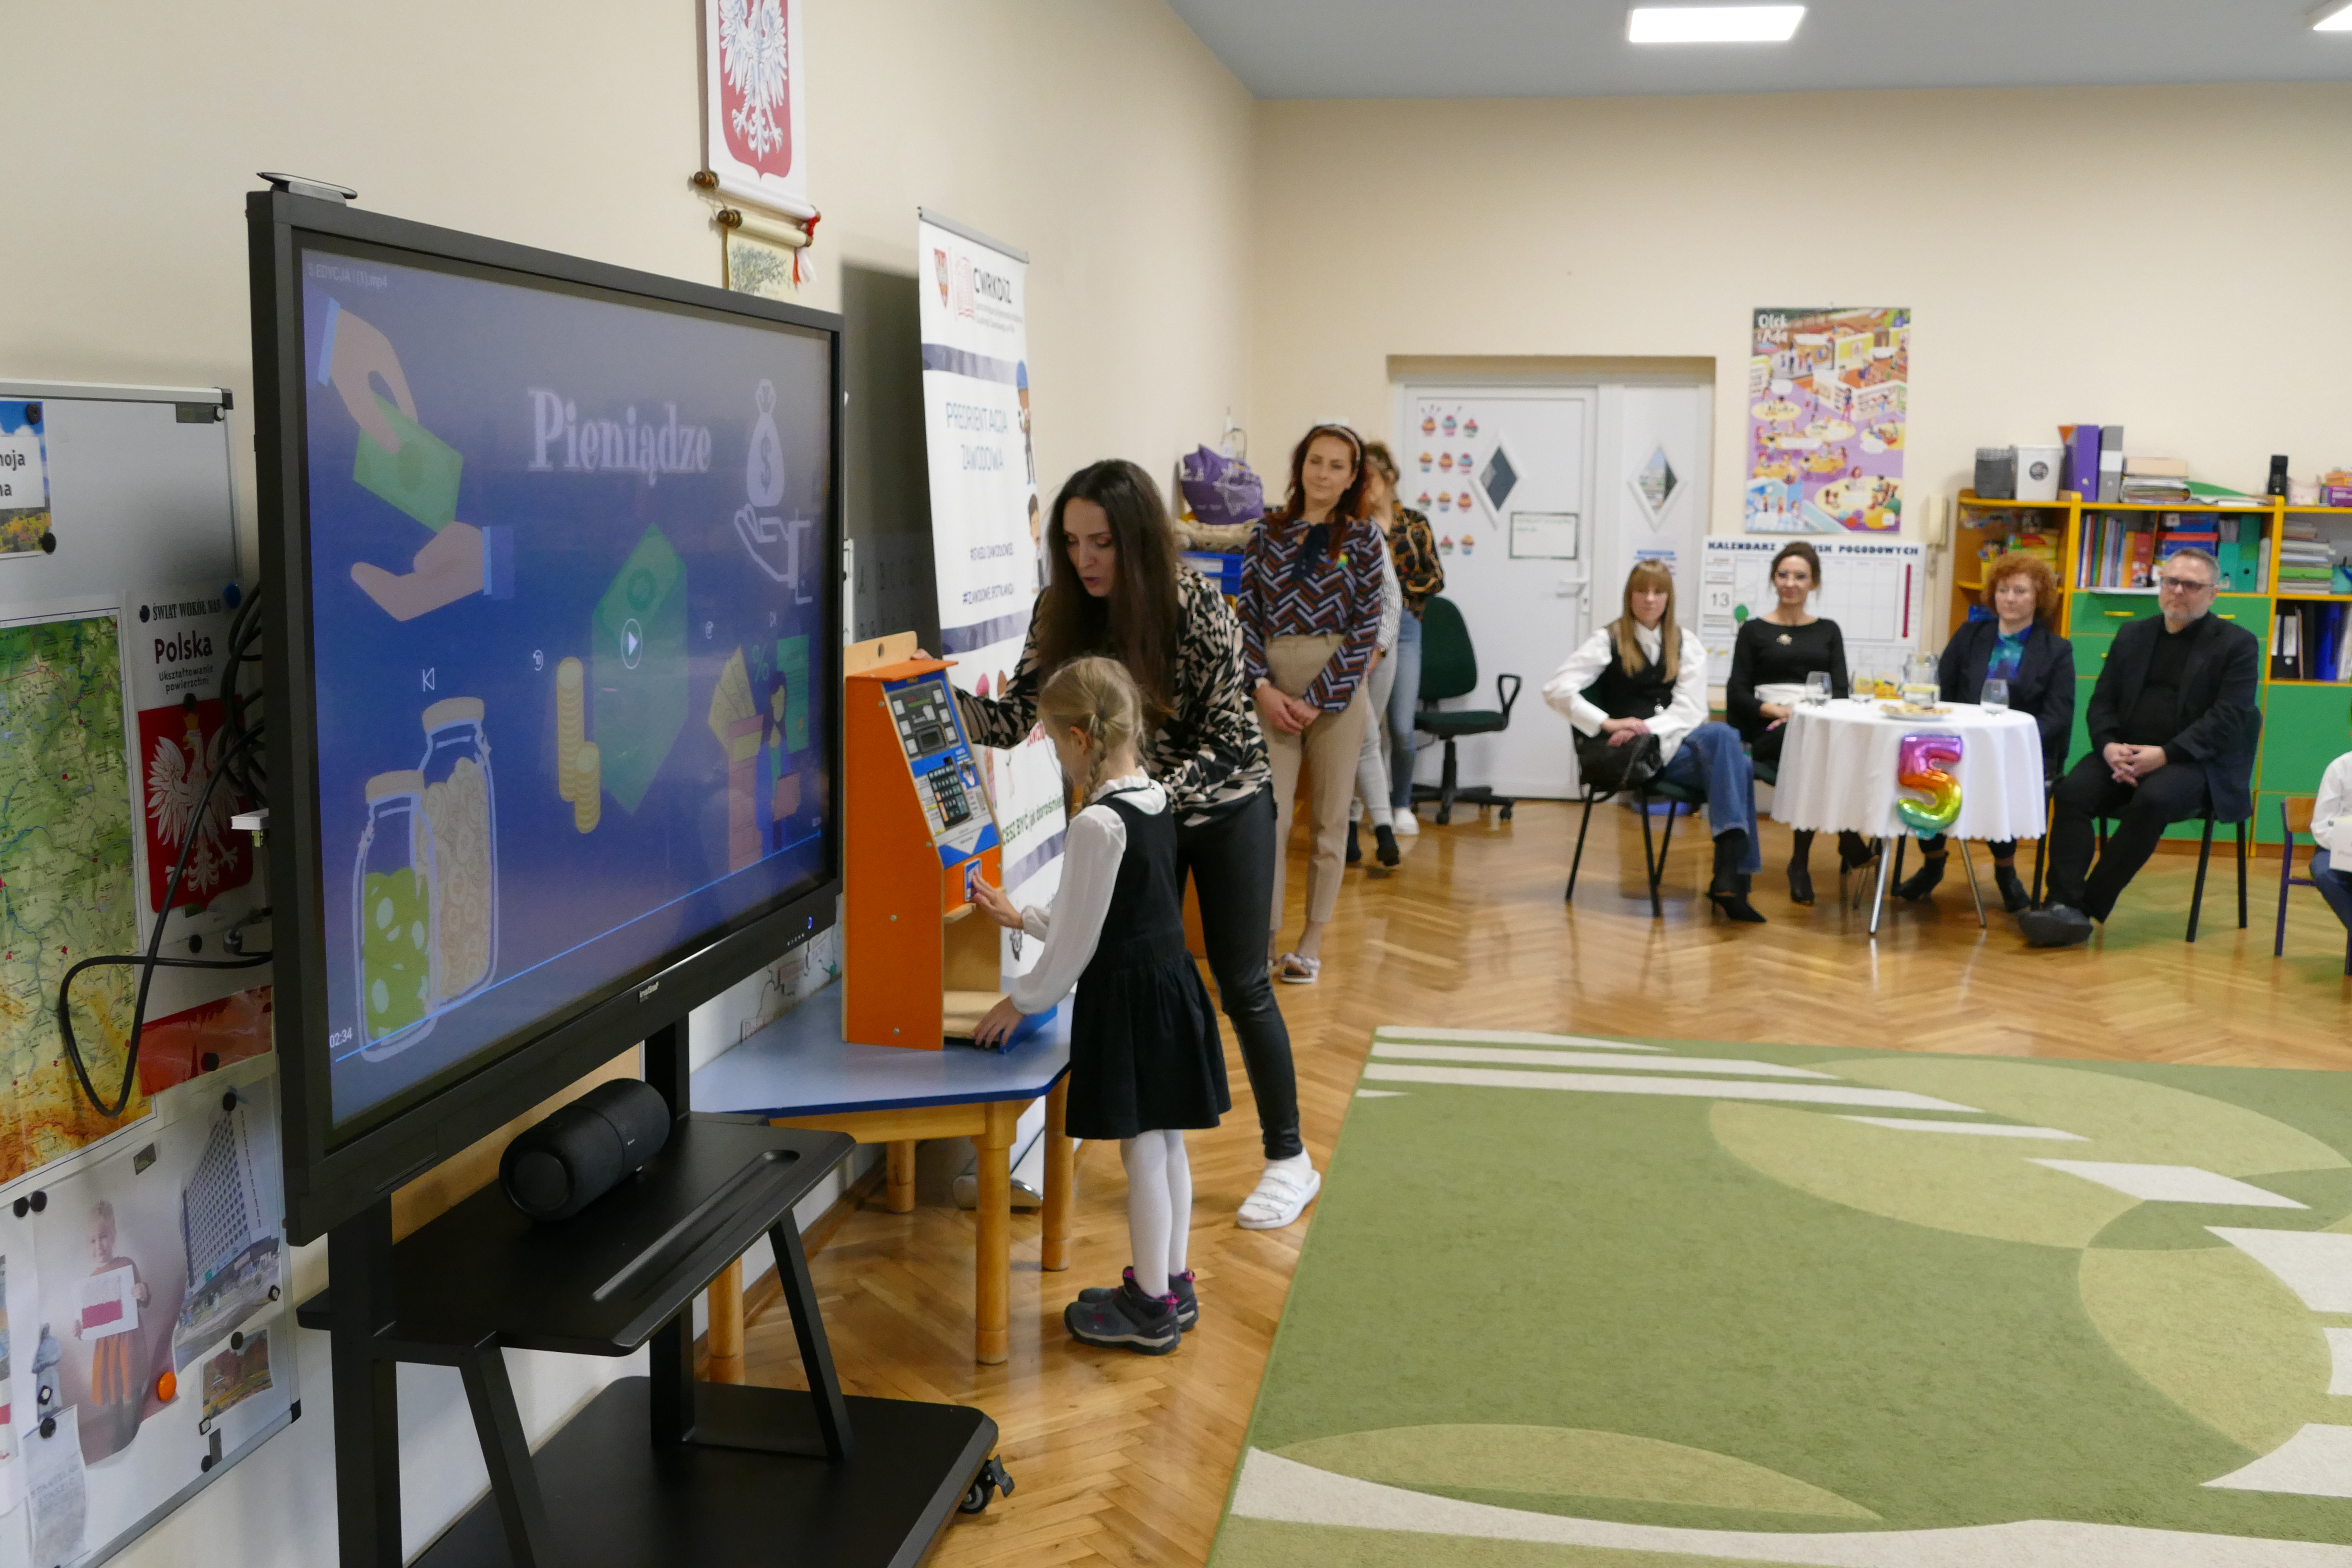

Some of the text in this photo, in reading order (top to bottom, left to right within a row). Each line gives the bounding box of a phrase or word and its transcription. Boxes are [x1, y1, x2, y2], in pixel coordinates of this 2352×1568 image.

[527, 388, 712, 487] Pieniądze
[1708, 541, 1776, 551] KALENDARZ
[1839, 545, 1918, 554] POGODOWYCH
[153, 598, 221, 620] ŚWIAT WOKÓŁ NAS
[1712, 592, 1730, 608] 13
[155, 630, 213, 664] Polska
[159, 665, 214, 681] Ukształtowanie
[165, 677, 209, 694] powierzchni
[1896, 733, 1963, 836] 5
[329, 1027, 352, 1048] 02:34
